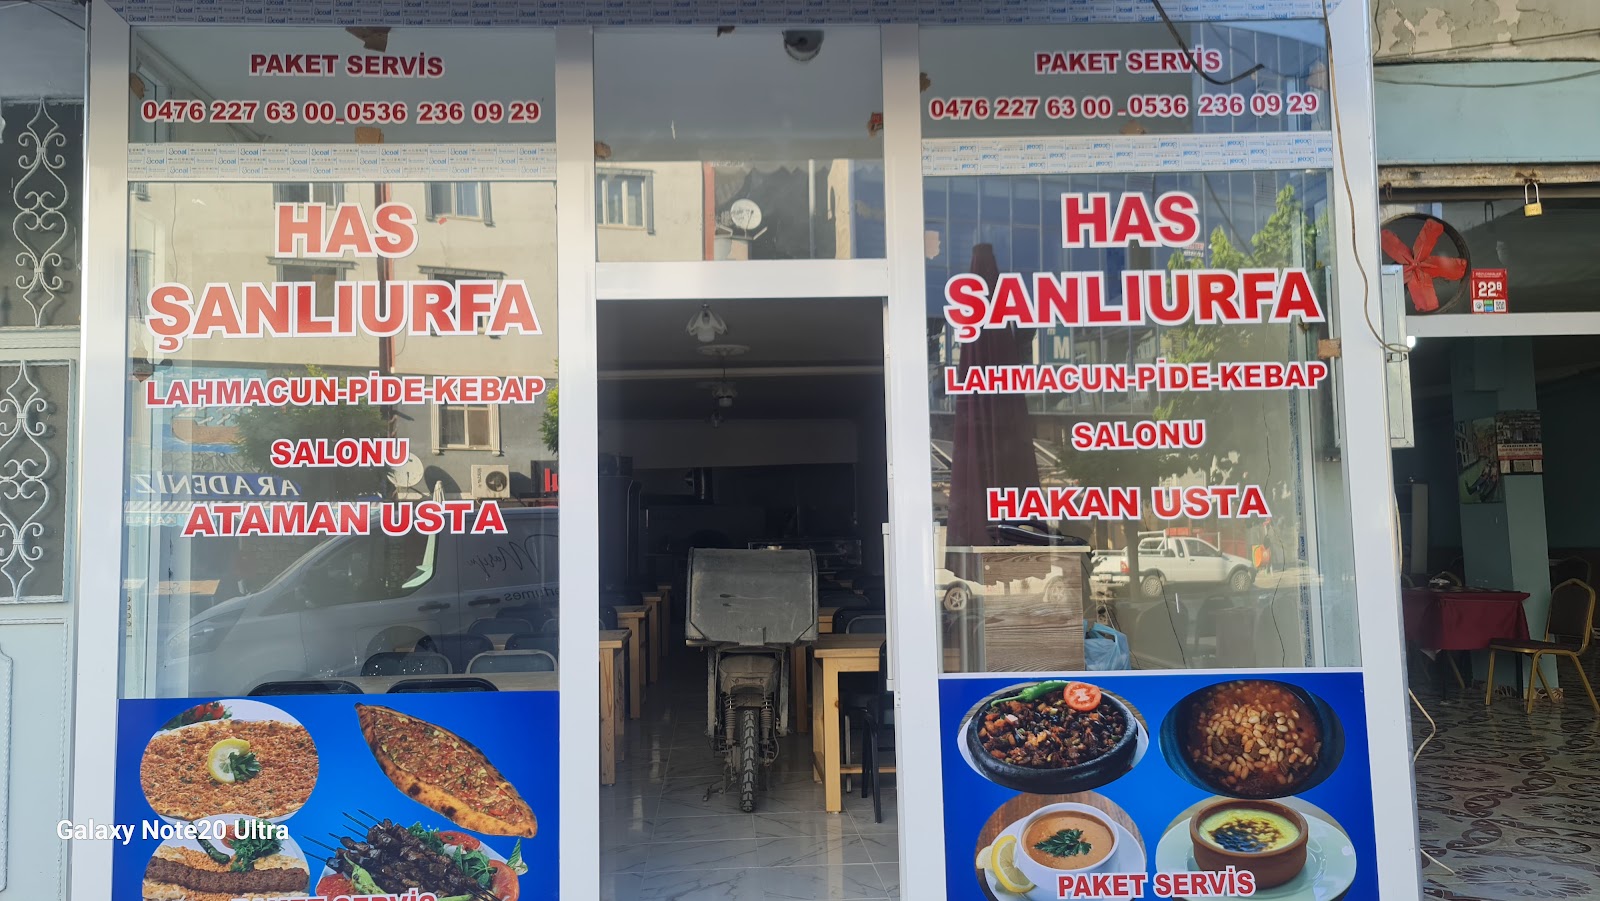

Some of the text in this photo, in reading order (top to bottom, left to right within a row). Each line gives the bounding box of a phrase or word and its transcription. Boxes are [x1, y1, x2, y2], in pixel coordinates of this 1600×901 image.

[250, 52, 444, 77] PAKET SERVİS
[1036, 48, 1222, 74] PAKET SERVİS
[142, 100, 205, 122] 0476
[212, 101, 258, 122] 227
[265, 101, 298, 122] 63
[418, 102, 464, 123] 236
[472, 102, 504, 123] 09
[510, 102, 541, 123] 29
[929, 98, 990, 120] 0476
[995, 98, 1040, 119] 227
[1046, 98, 1076, 118] 63
[1199, 95, 1244, 116] 236
[1252, 95, 1282, 114] 09
[1288, 94, 1319, 114] 29
[277, 203, 416, 255] HAS
[1064, 193, 1198, 246] HAS
[148, 282, 538, 354] ŞANLIURFA
[946, 270, 1322, 341] ŞANLIURFA
[146, 370, 545, 407] LAHMACUN-PİDE-KEBAP
[945, 358, 1327, 394] LAHMACUN-PİDE-KEBAP
[270, 439, 408, 467] SALONU
[1072, 421, 1205, 450] SALONU
[183, 501, 506, 537] ATAMAN USTA
[987, 486, 1270, 521] HAKAN USTA
[1057, 867, 1255, 898] PAKET SERVİS
